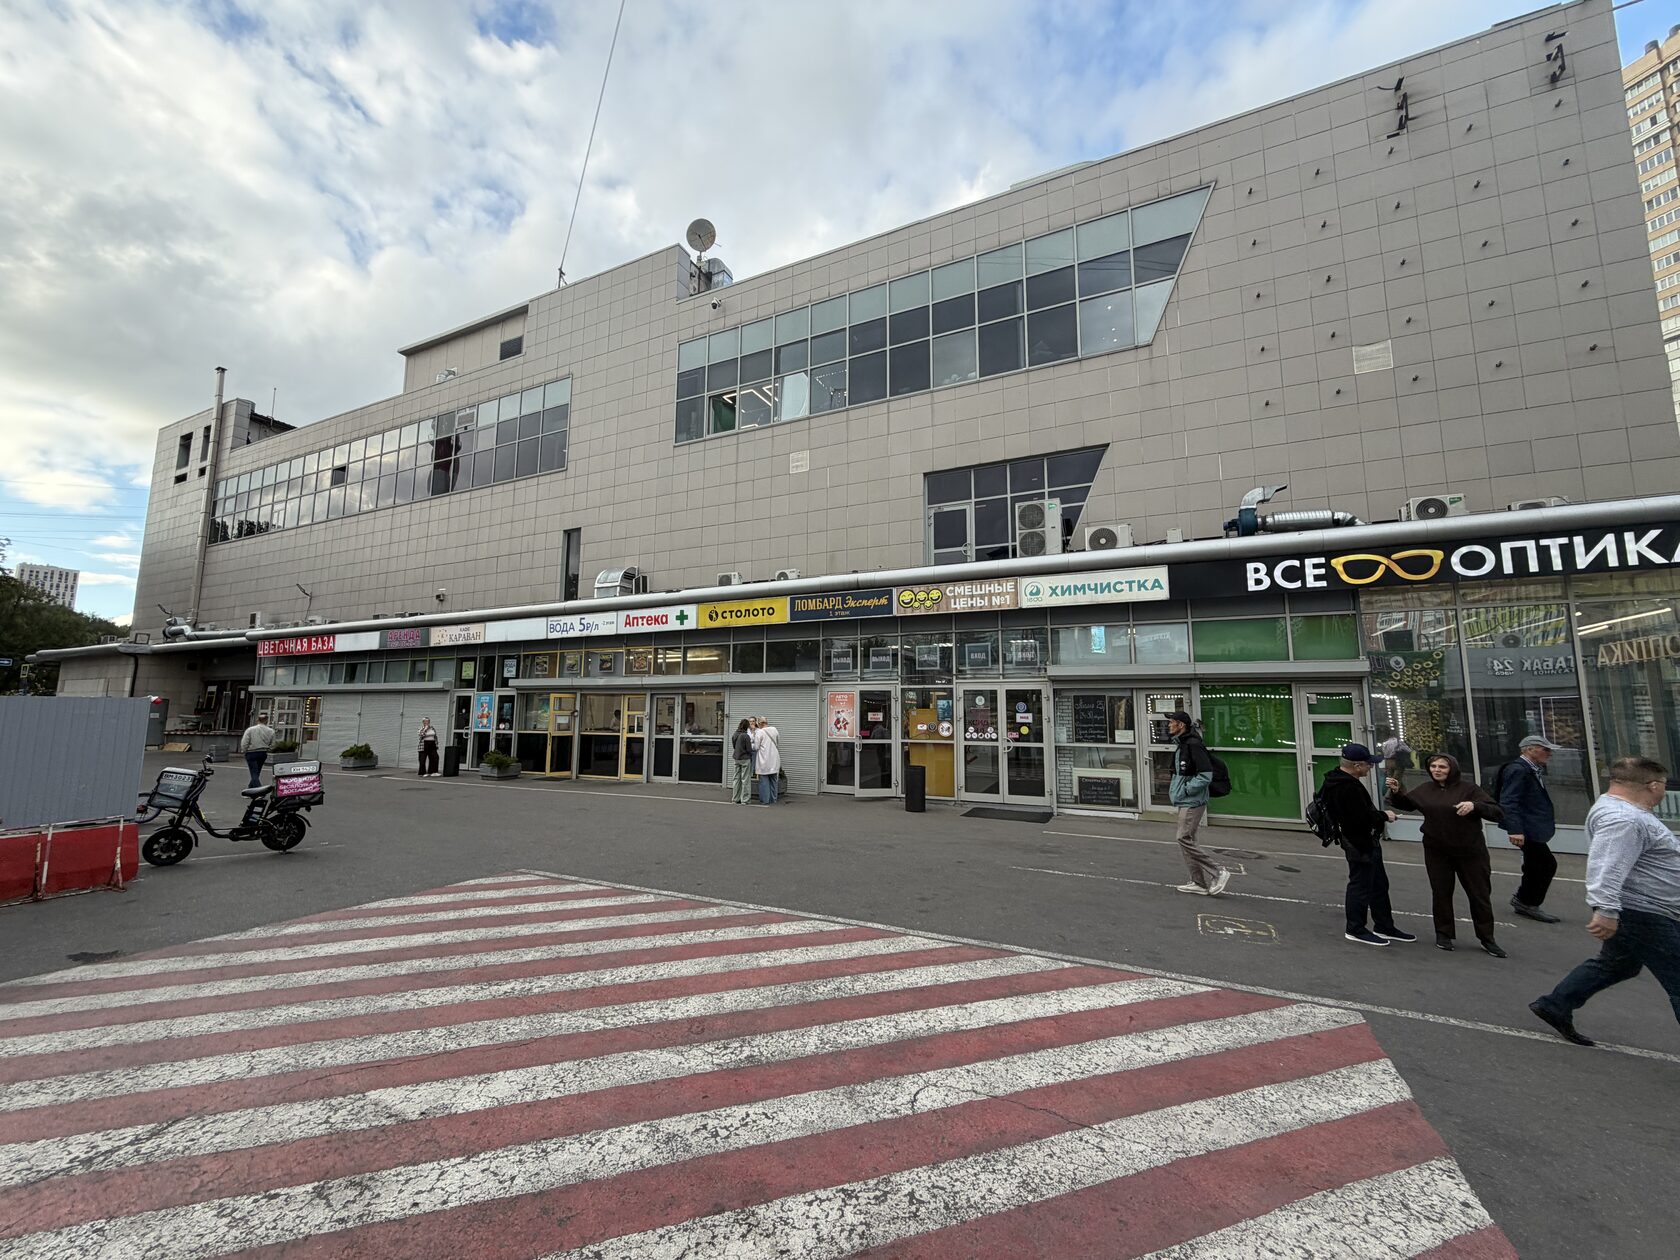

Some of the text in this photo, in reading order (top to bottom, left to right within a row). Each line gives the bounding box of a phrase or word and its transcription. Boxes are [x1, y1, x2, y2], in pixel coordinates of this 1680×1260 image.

[1246, 556, 1327, 591] ВСЕ
[946, 582, 1015, 596] СМЕШНЫЕ
[1048, 578, 1164, 598] ХИМЧИСТКА
[794, 595, 889, 612] ЛОМБАРД Эксперт
[951, 595, 1010, 610] ЦЕНЫ №1
[624, 613, 669, 628] Аптека
[721, 606, 775, 620] СТОЛОТО
[388, 630, 421, 641] АРЕНДА
[549, 622, 575, 635] ВОДА
[311, 636, 334, 651] БАЗА
[448, 631, 481, 643] КАРАВАН
